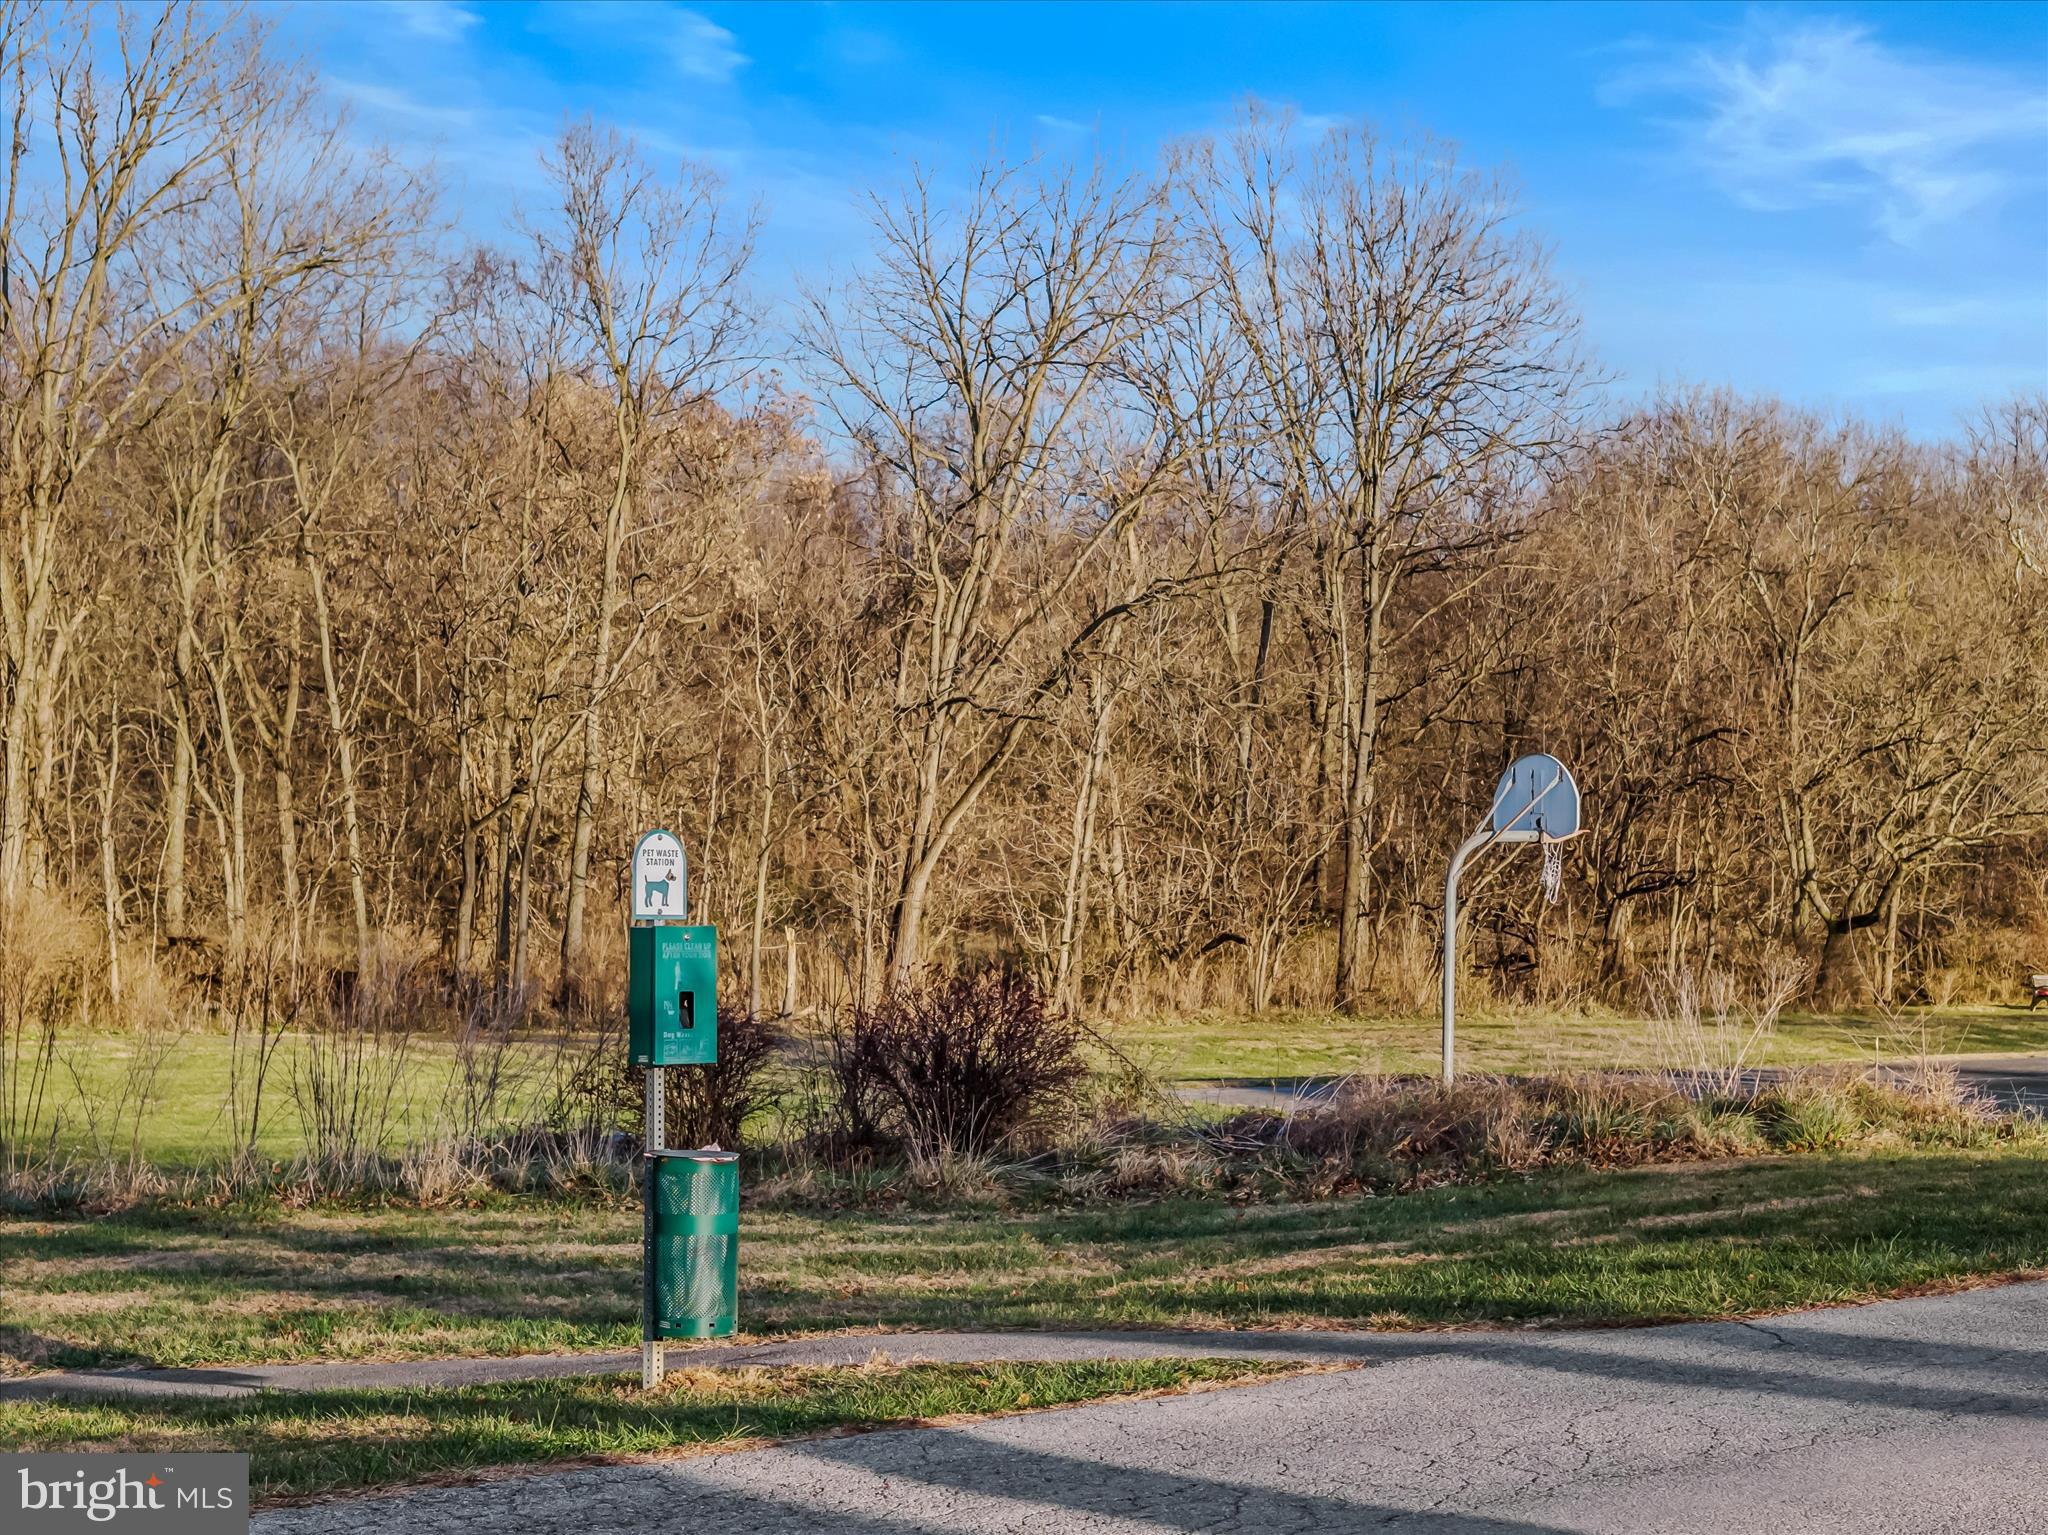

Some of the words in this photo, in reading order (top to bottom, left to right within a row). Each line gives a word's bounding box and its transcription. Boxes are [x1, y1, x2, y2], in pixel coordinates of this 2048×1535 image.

[642, 848, 655, 857] PET
[656, 849, 679, 858] WASTE
[646, 857, 675, 867] STATION
